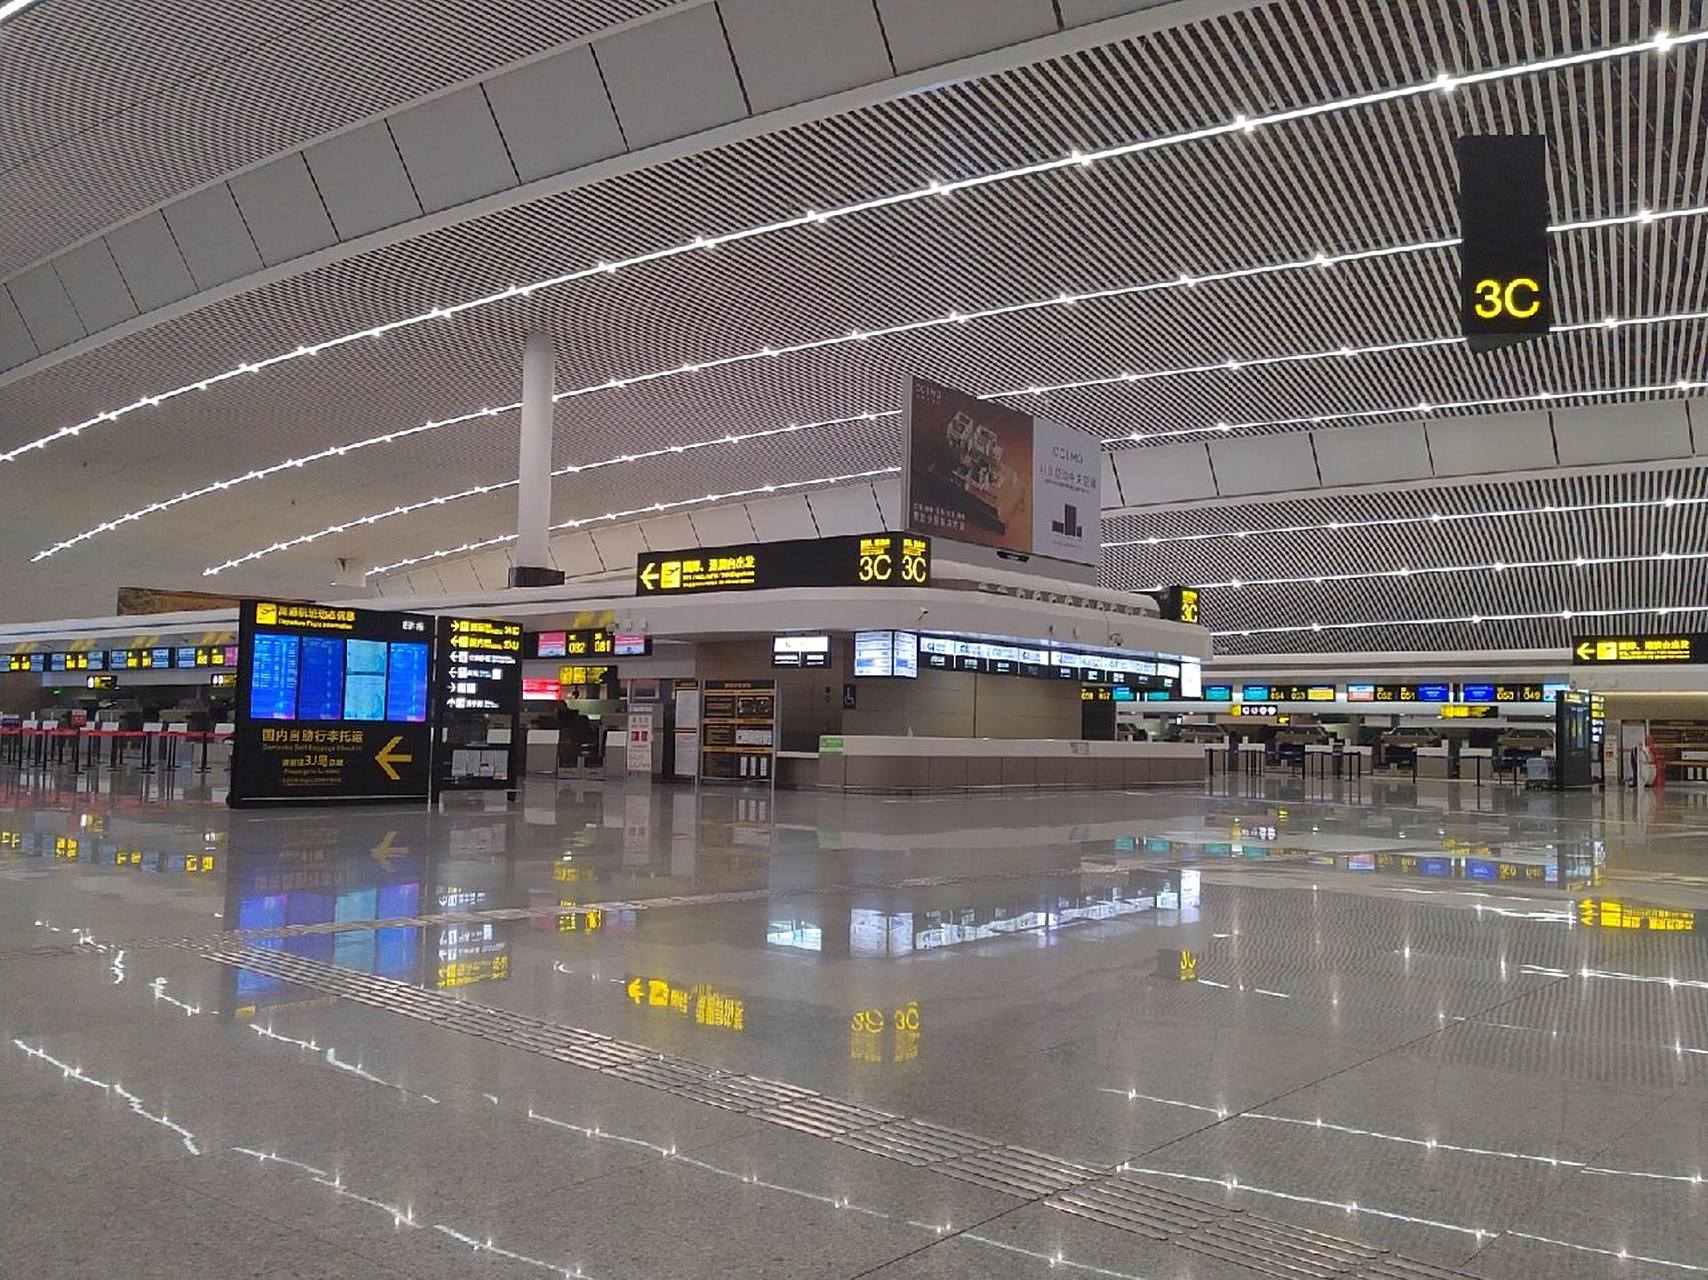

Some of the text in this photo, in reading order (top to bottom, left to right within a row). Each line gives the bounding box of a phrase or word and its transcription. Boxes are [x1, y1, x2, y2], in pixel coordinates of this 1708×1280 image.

[1475, 278, 1540, 318] 3C
[859, 554, 892, 581] 3C
[902, 554, 927, 583] 3C
[1181, 603, 1198, 623] 3C
[594, 640, 611, 653] 081
[1523, 690, 1541, 700] 049
[262, 728, 364, 743] 国内自助行李托运
